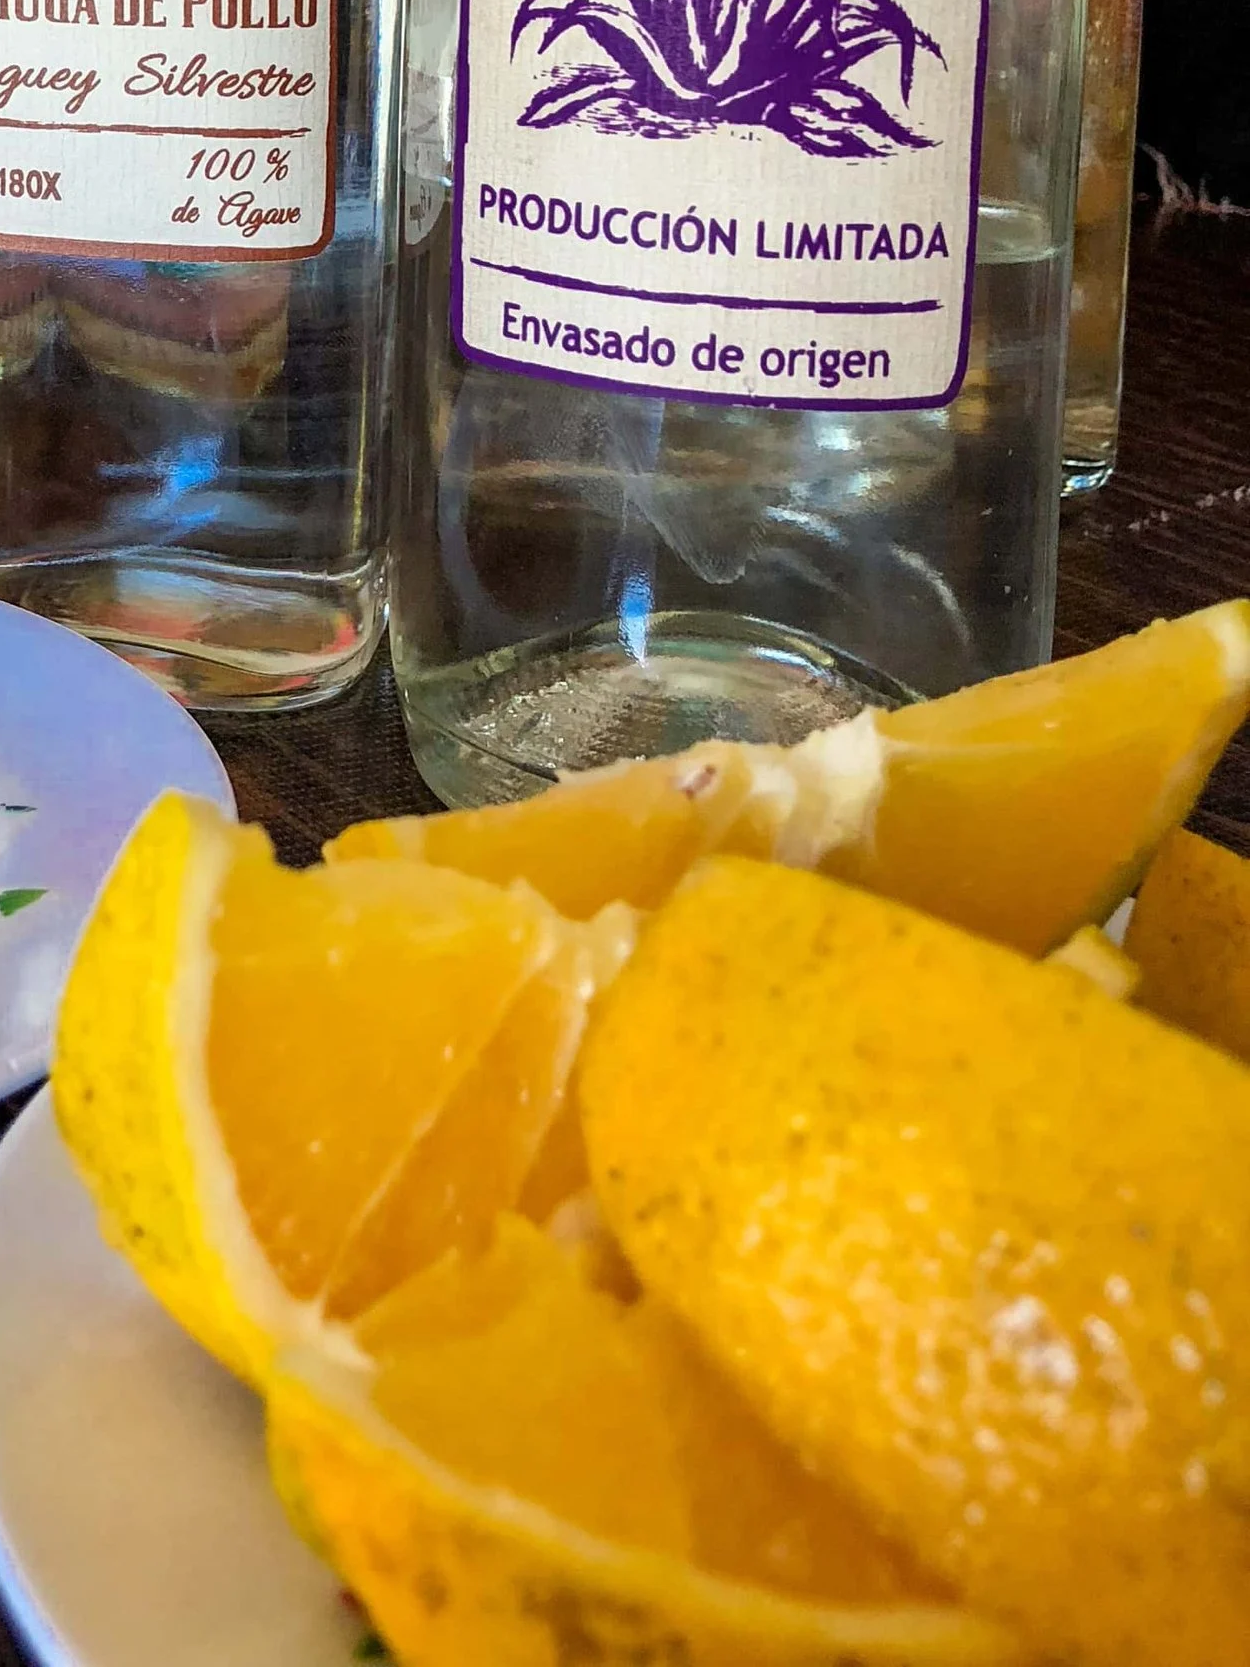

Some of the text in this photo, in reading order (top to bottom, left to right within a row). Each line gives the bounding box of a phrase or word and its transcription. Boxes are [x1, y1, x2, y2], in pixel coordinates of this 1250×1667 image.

[124, 52, 317, 99] Silvestre
[171, 191, 301, 238] de Agave
[479, 183, 737, 256] PRODUCCIÓN
[756, 219, 950, 261] LIMITADA
[503, 301, 891, 389] Envasado de origen
